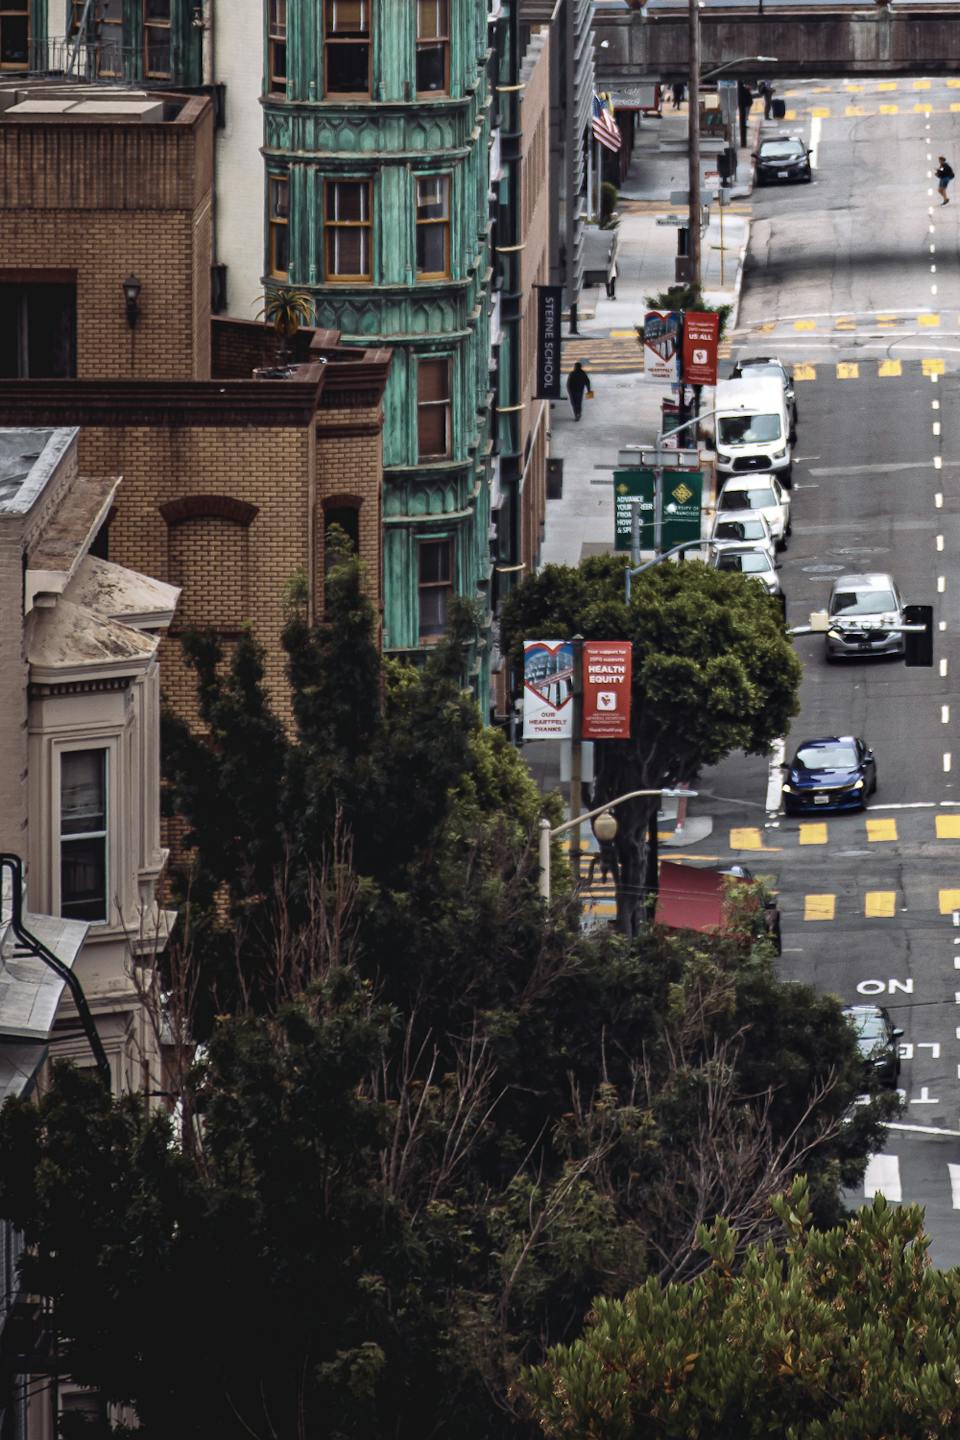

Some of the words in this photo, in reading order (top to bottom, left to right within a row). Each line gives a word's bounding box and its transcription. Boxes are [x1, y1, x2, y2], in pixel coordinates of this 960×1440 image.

[543, 296, 554, 339] STERNE
[543, 342, 554, 388] SCHOOL
[588, 665, 625, 673] HEALTH
[589, 675, 625, 683] EQUITY
[856, 978, 914, 995] NO
